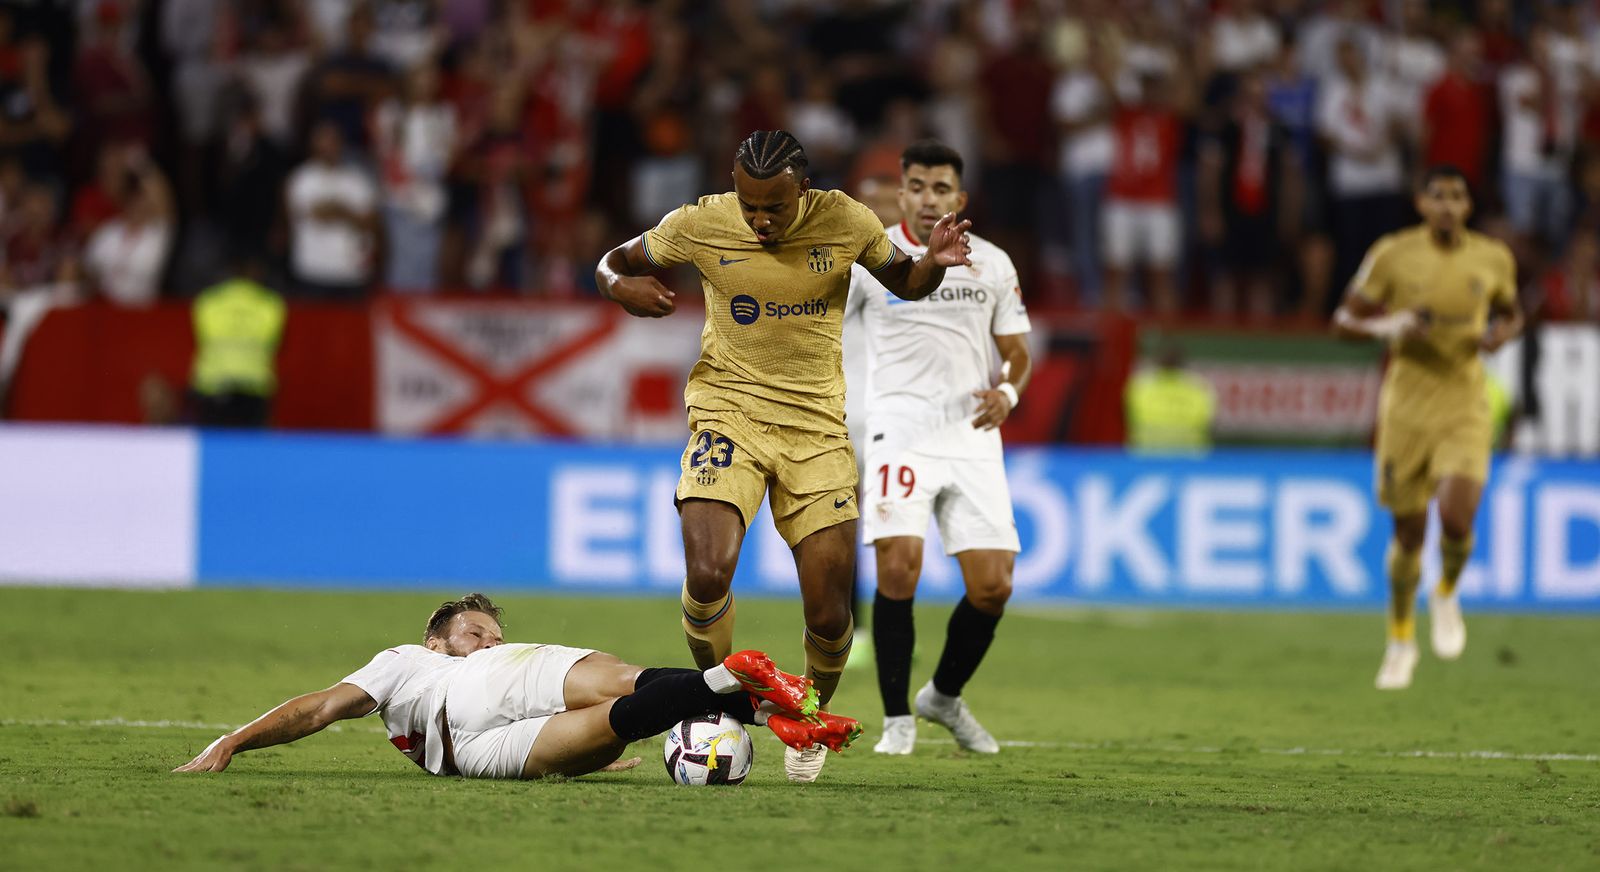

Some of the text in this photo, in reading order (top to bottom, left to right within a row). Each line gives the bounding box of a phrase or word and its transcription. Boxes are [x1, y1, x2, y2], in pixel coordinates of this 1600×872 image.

[914, 286, 987, 304] EGIRO
[765, 299, 829, 319] Spotify
[690, 431, 735, 468] 23
[878, 463, 916, 498] 19
